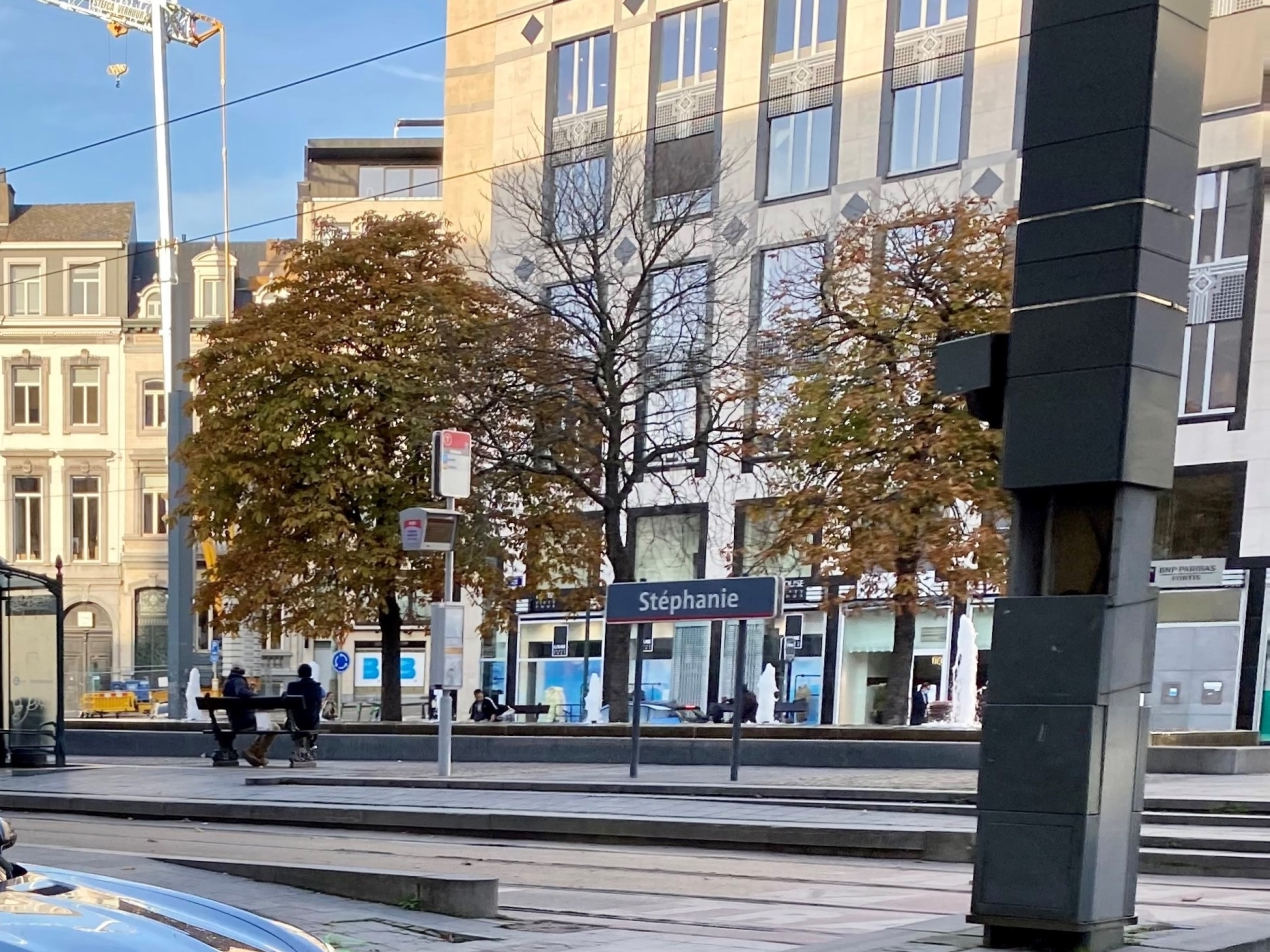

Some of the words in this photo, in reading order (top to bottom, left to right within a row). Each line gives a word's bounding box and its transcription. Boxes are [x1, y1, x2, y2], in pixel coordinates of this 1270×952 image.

[1159, 566, 1178, 574] BNP
[1179, 564, 1216, 573] PARIBAS
[639, 587, 739, 615] Stéphanie
[363, 658, 379, 679] B
